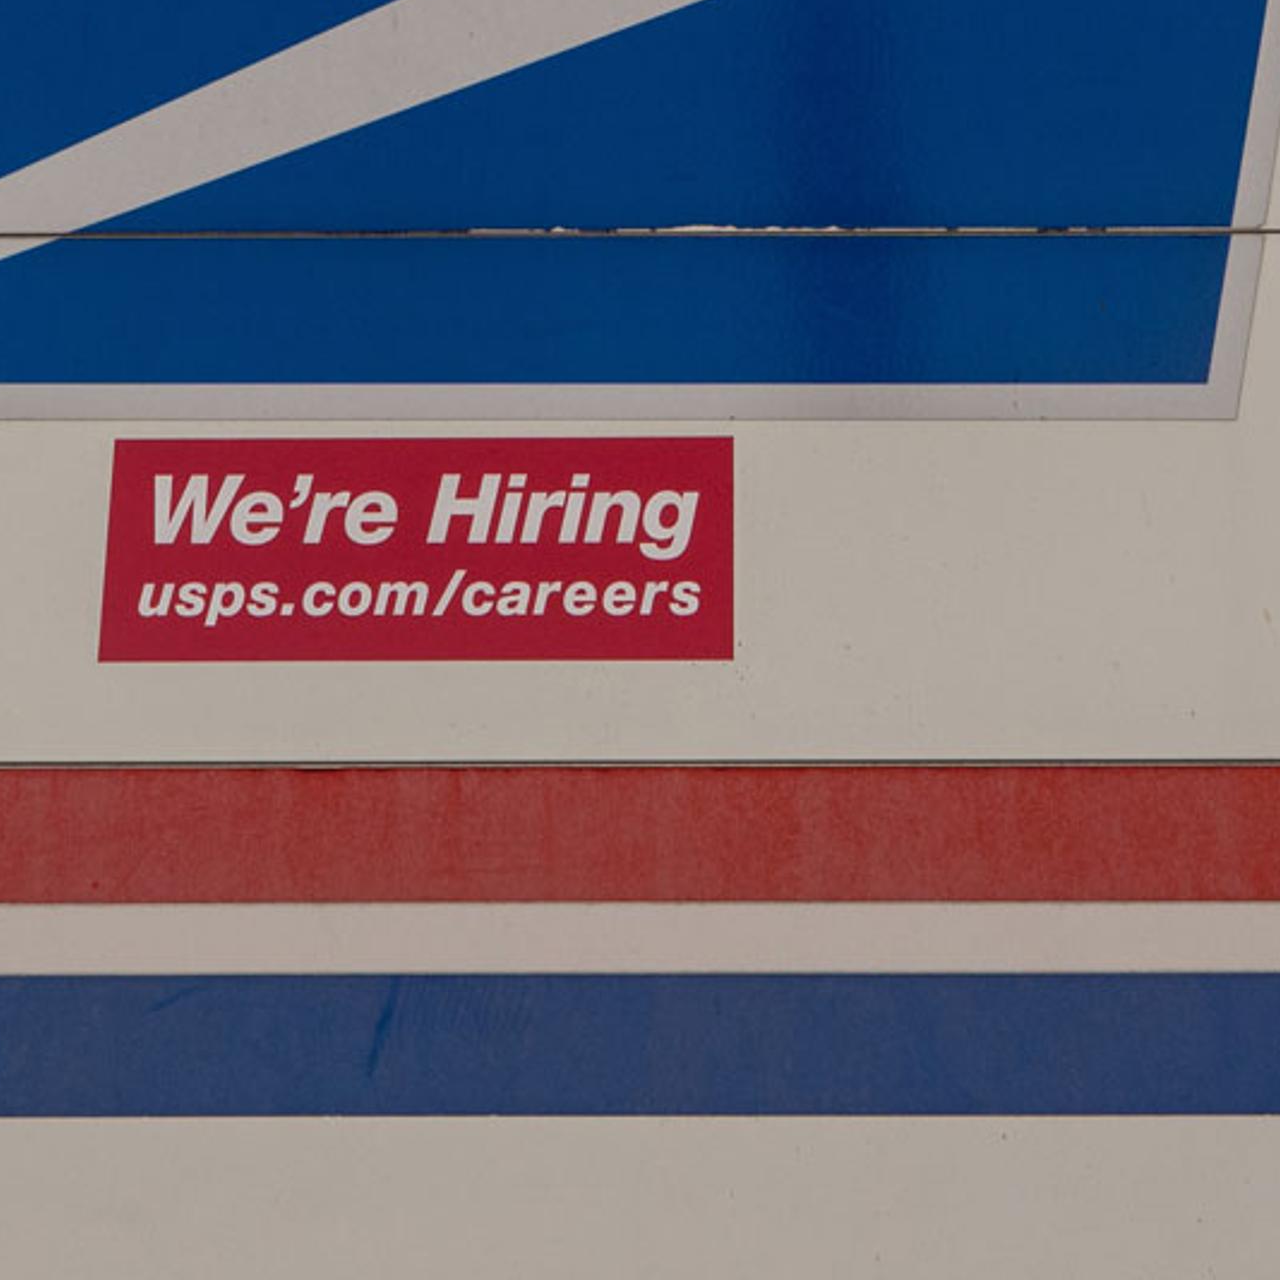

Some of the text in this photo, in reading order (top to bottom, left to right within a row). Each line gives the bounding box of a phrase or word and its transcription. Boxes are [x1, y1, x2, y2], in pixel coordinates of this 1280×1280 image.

[152, 473, 700, 561] We’re Hiring
[137, 570, 701, 626] usps.com/careers
